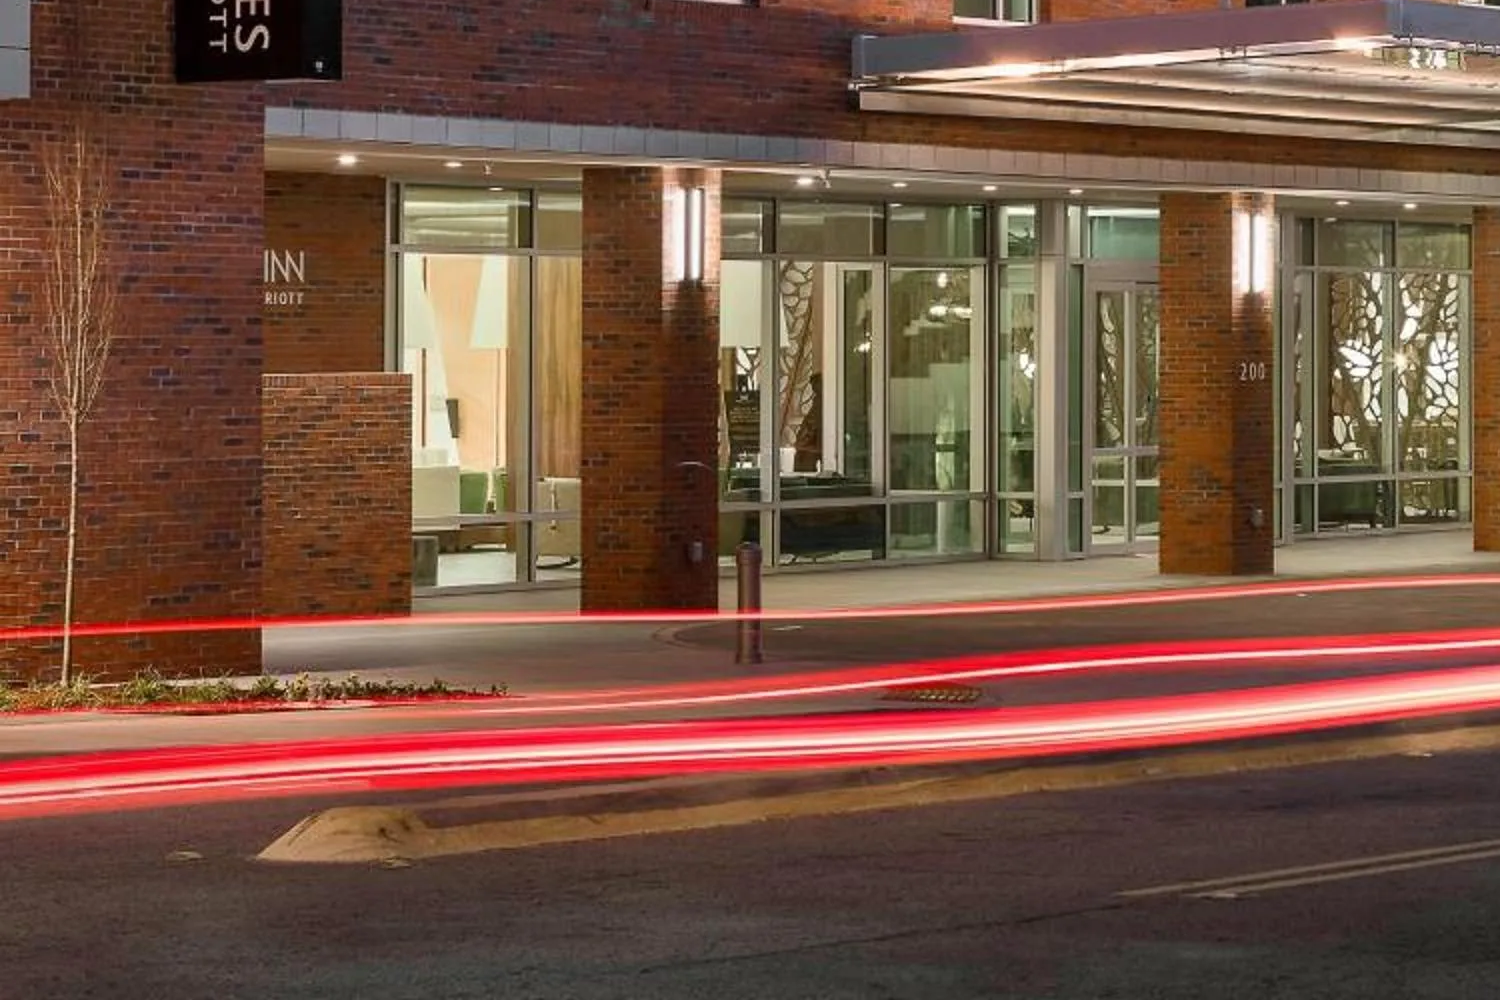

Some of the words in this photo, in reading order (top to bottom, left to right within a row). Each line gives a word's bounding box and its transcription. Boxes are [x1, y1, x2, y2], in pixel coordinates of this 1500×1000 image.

[263, 249, 305, 282] INN
[264, 291, 304, 305] RIOTT
[1240, 361, 1265, 381] 200
